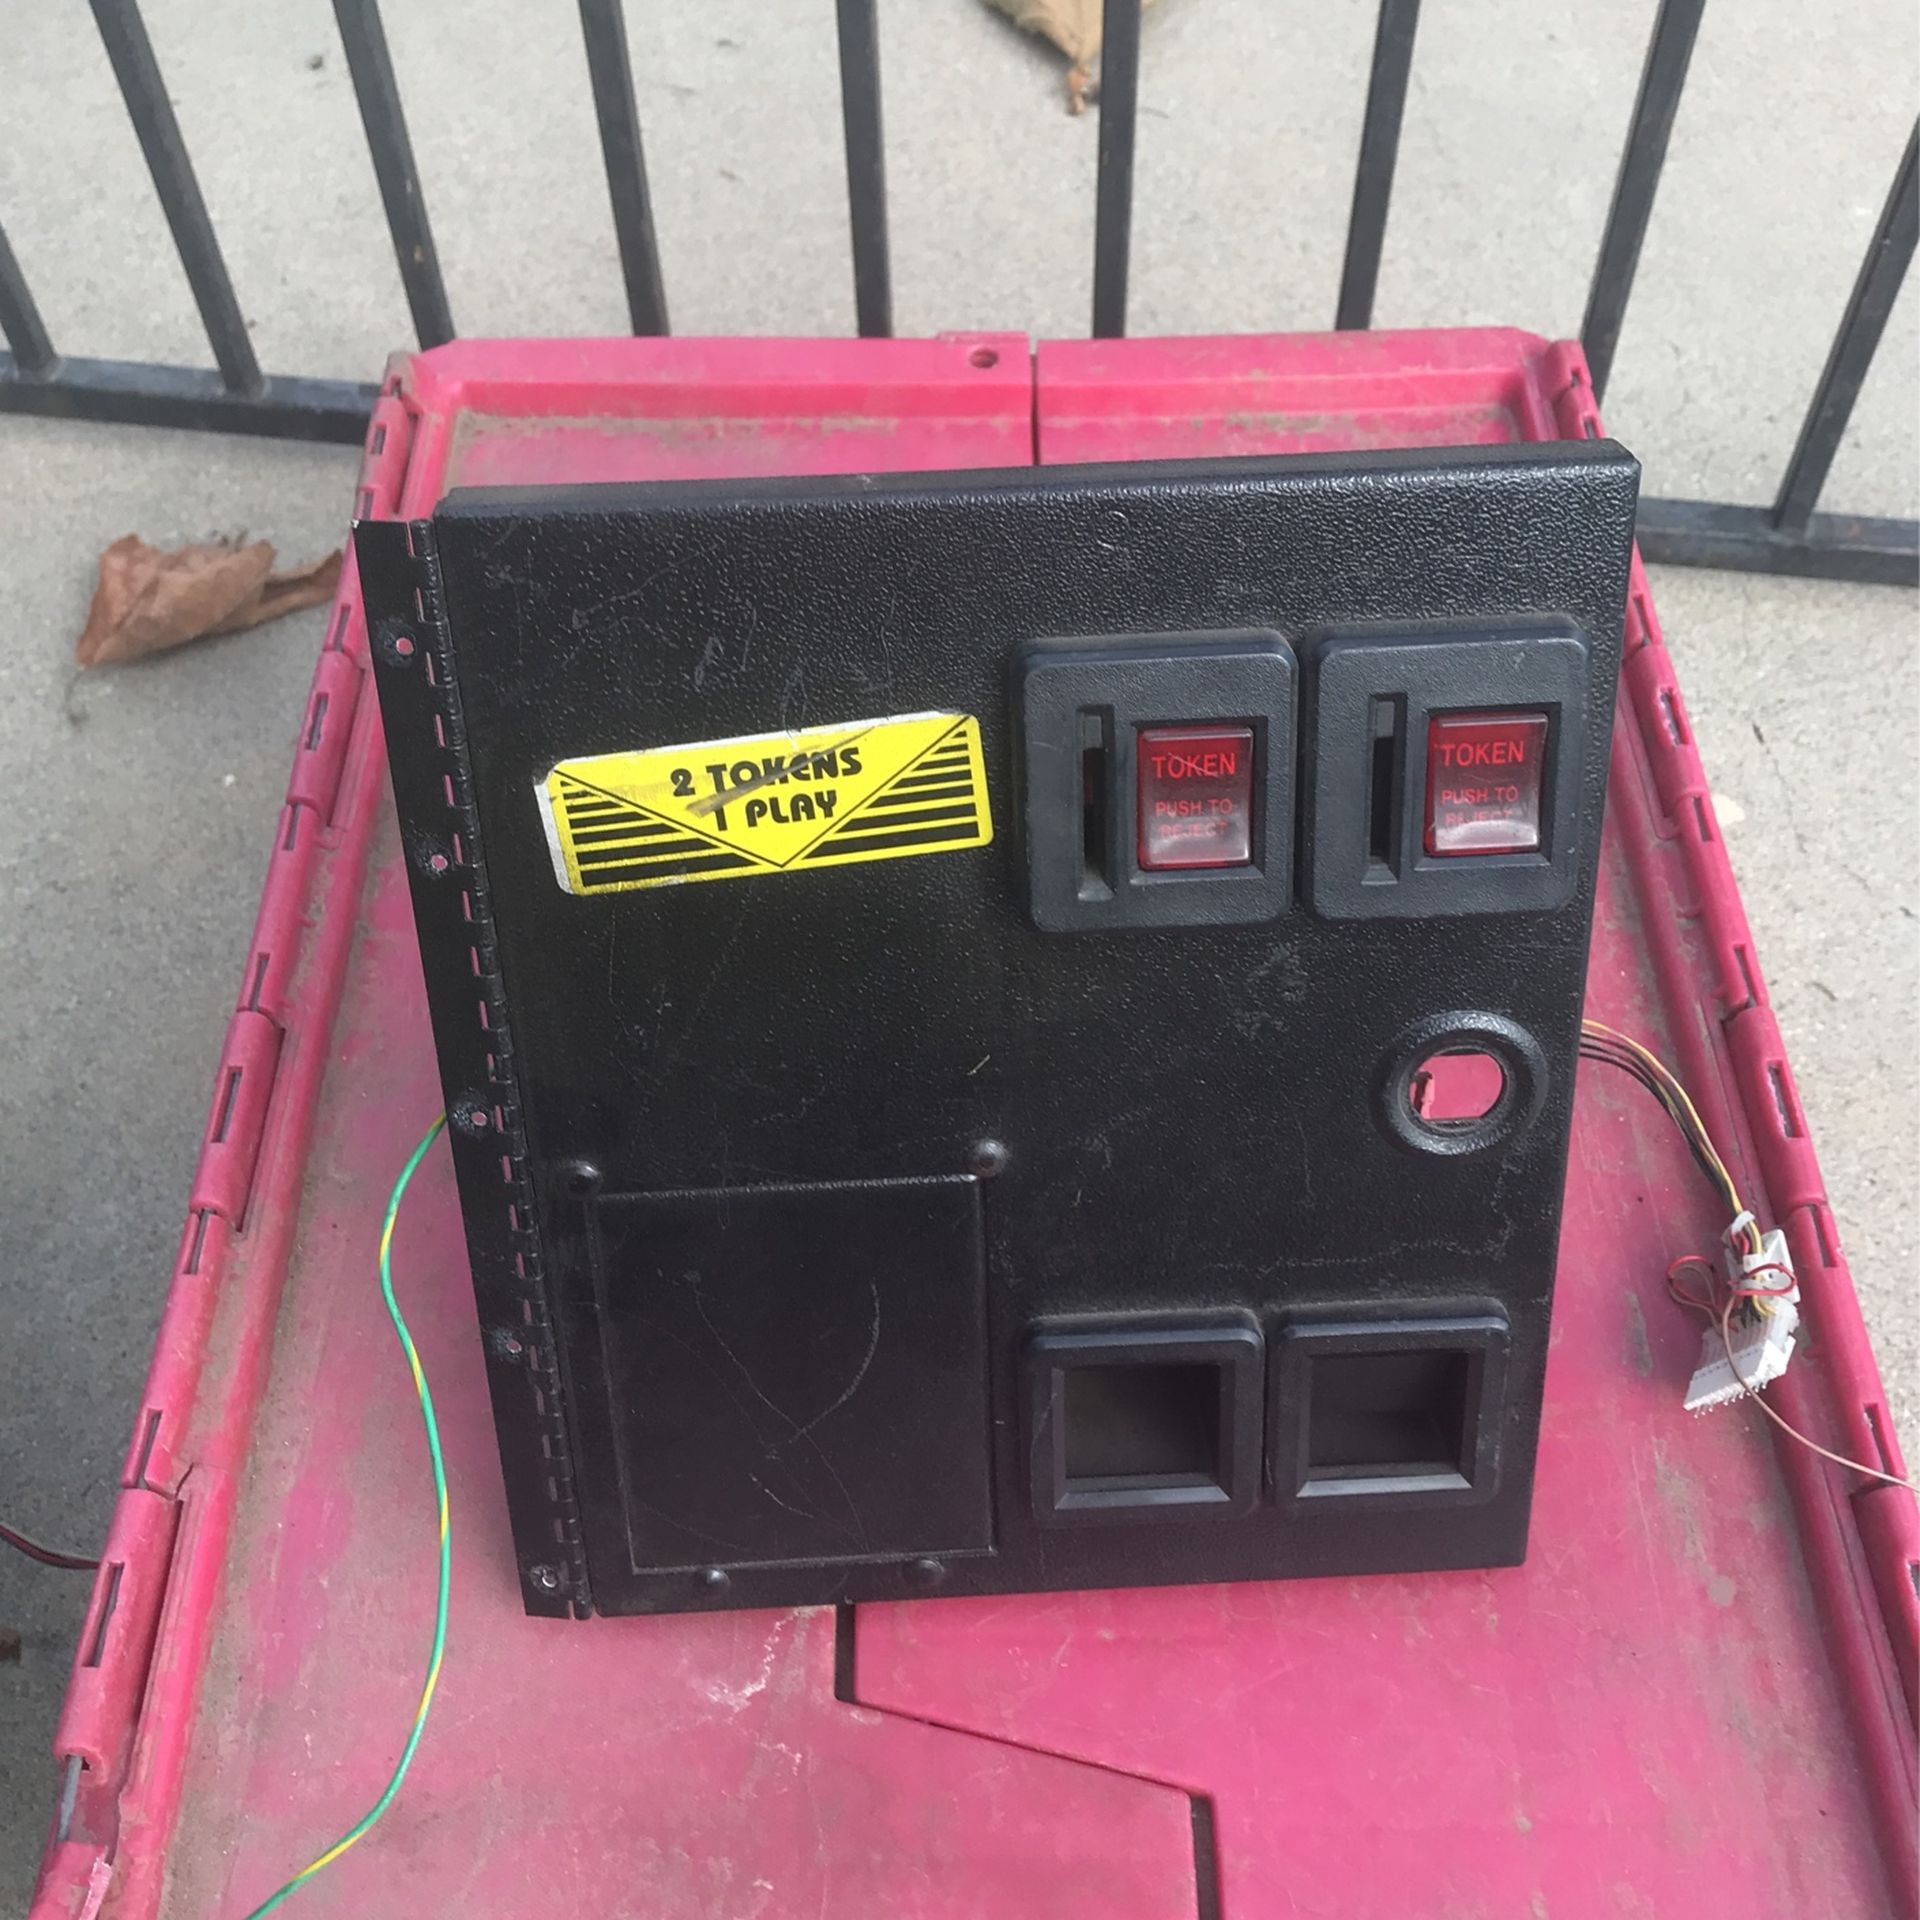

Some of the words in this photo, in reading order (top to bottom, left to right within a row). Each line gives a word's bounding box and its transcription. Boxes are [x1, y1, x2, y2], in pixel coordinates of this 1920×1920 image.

[1152, 752, 1236, 779] TOKEN
[1440, 741, 1525, 766] TOKEN
[670, 768, 696, 797] 2
[706, 746, 862, 794] TOKENS
[1155, 800, 1201, 817] PUSH
[1208, 798, 1233, 815] TO
[1441, 788, 1488, 805] PUSH
[1495, 786, 1519, 802] TO
[744, 790, 839, 828] PLAY
